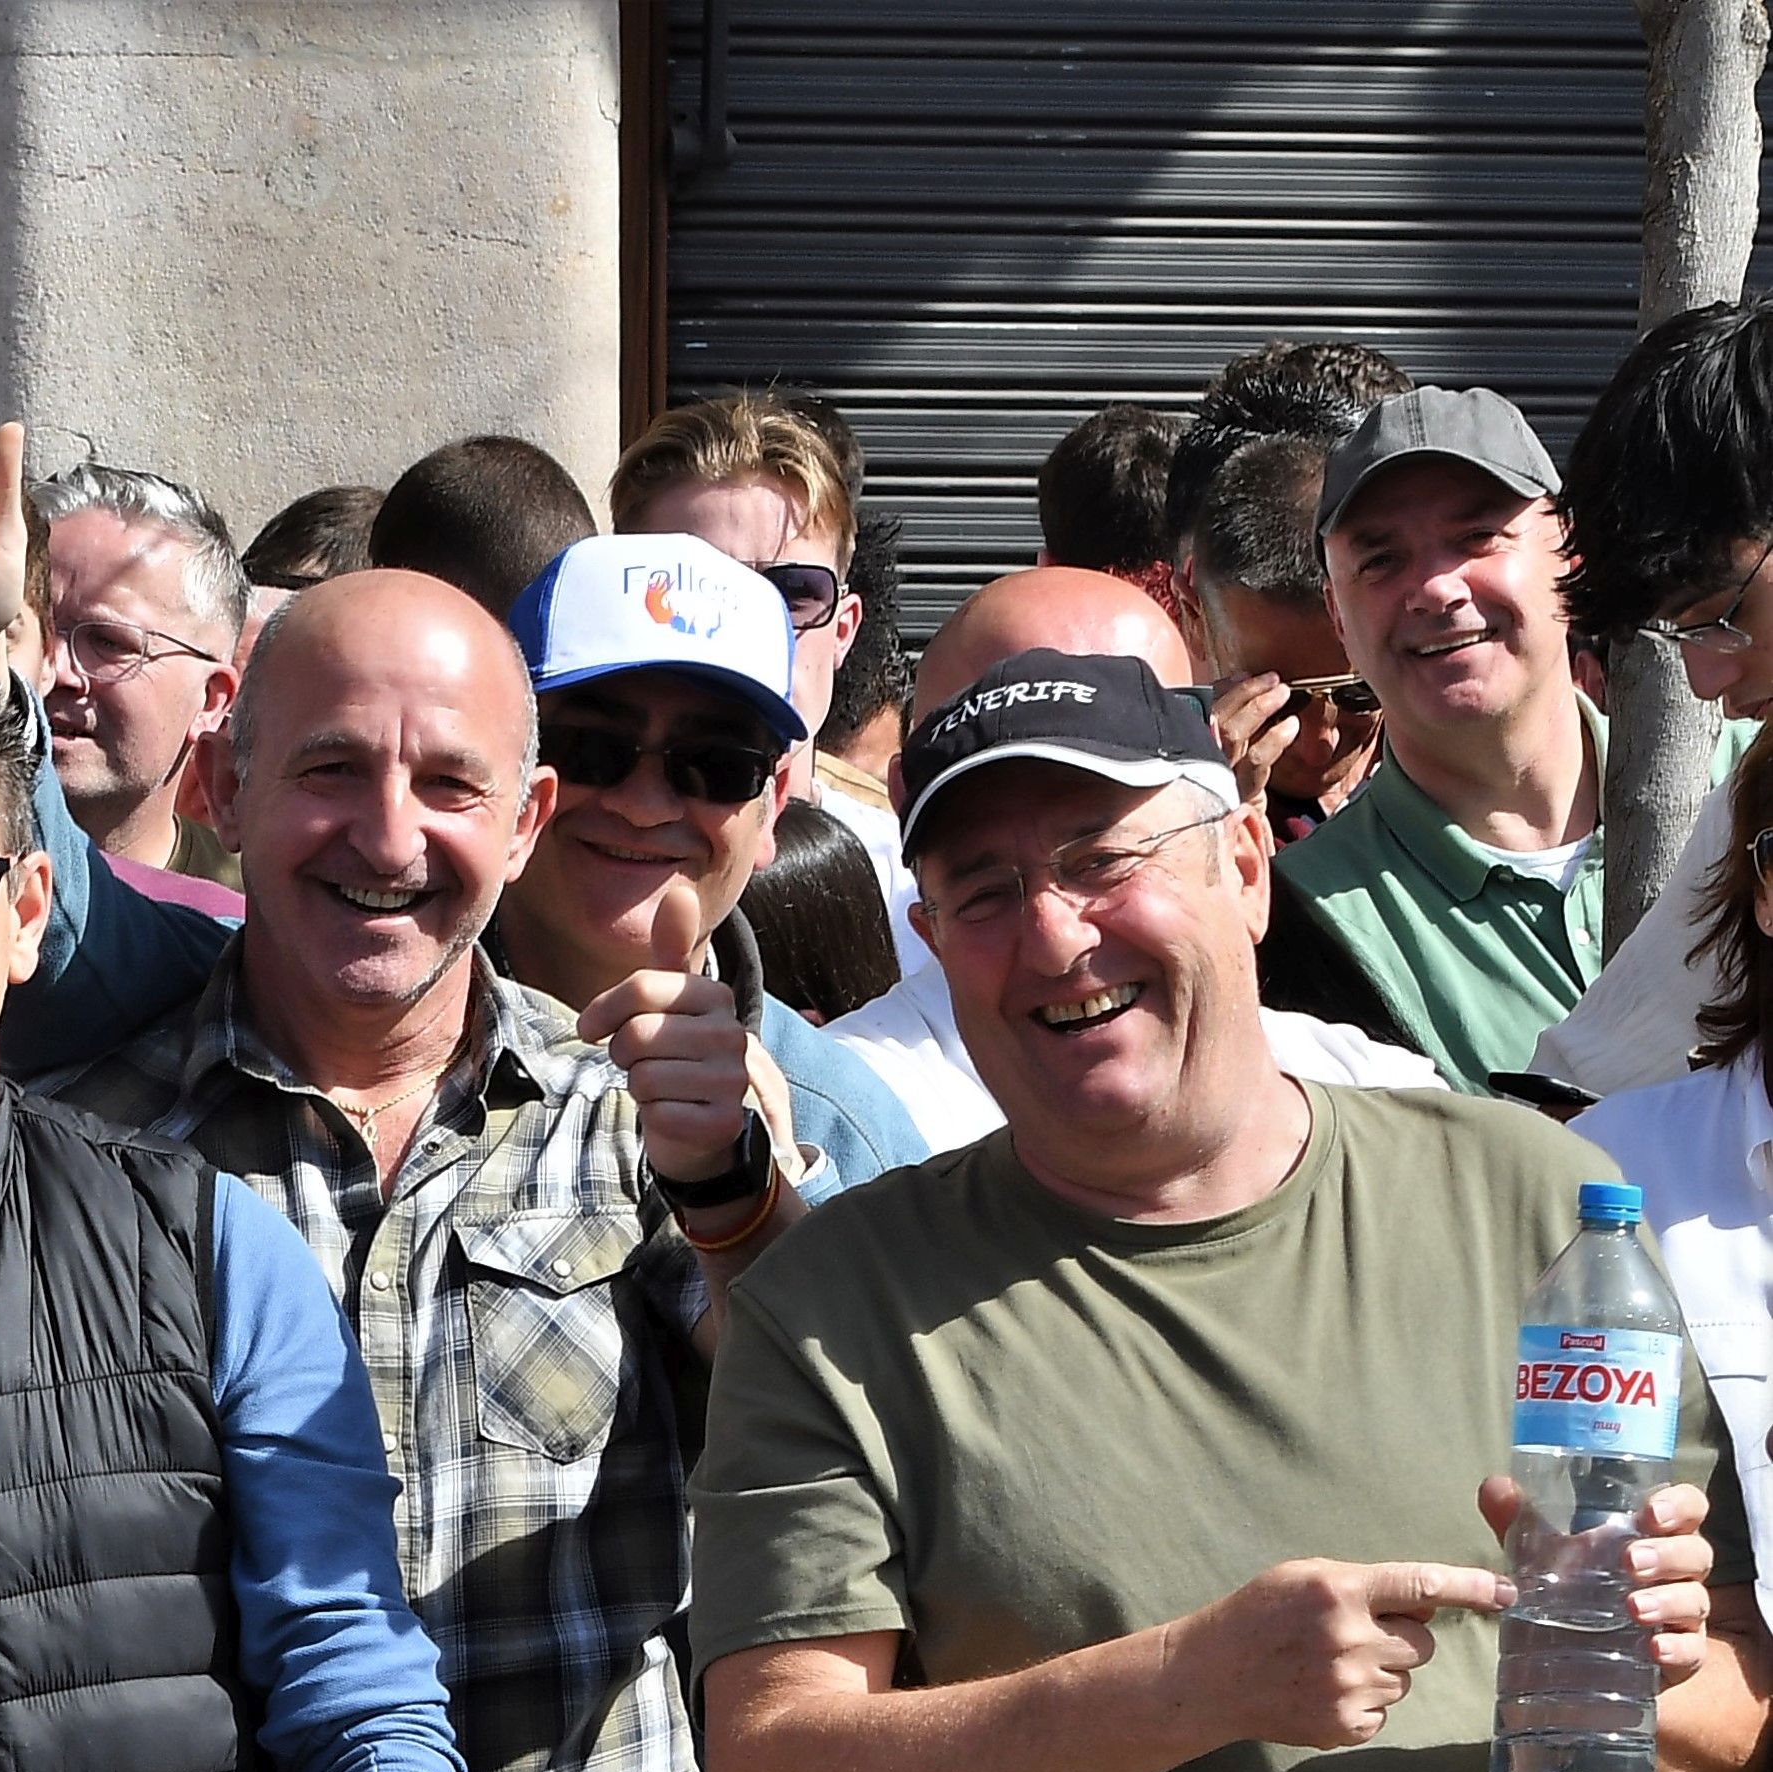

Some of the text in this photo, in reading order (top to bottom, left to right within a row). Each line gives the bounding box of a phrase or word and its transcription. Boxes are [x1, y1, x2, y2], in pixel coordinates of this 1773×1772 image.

[929, 680, 1098, 744] TENERIFE
[1562, 1334, 1603, 1348] Pascual
[1516, 1363, 1657, 1407] BEZOYA
